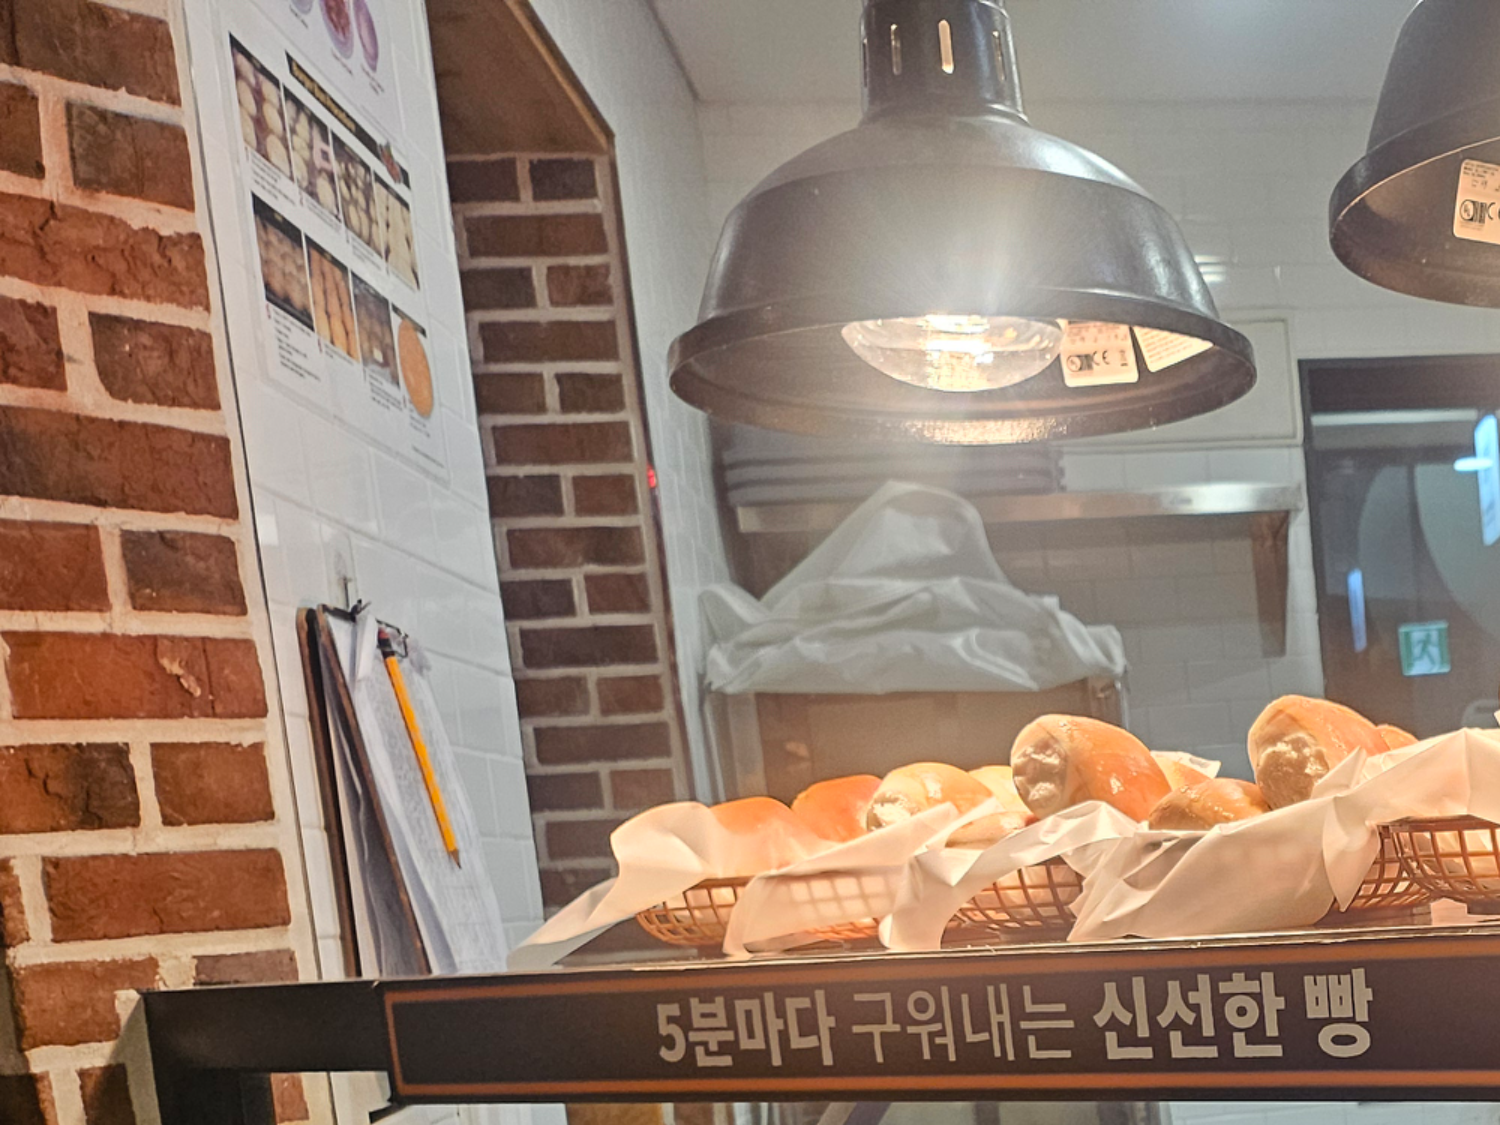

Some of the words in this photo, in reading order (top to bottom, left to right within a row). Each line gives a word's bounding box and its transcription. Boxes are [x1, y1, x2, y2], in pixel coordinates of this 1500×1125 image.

[656, 988, 836, 1068] 5분마다
[850, 983, 1077, 1063] 구워내는
[1092, 971, 1286, 1061] 신선한
[1303, 967, 1374, 1060] 빵
